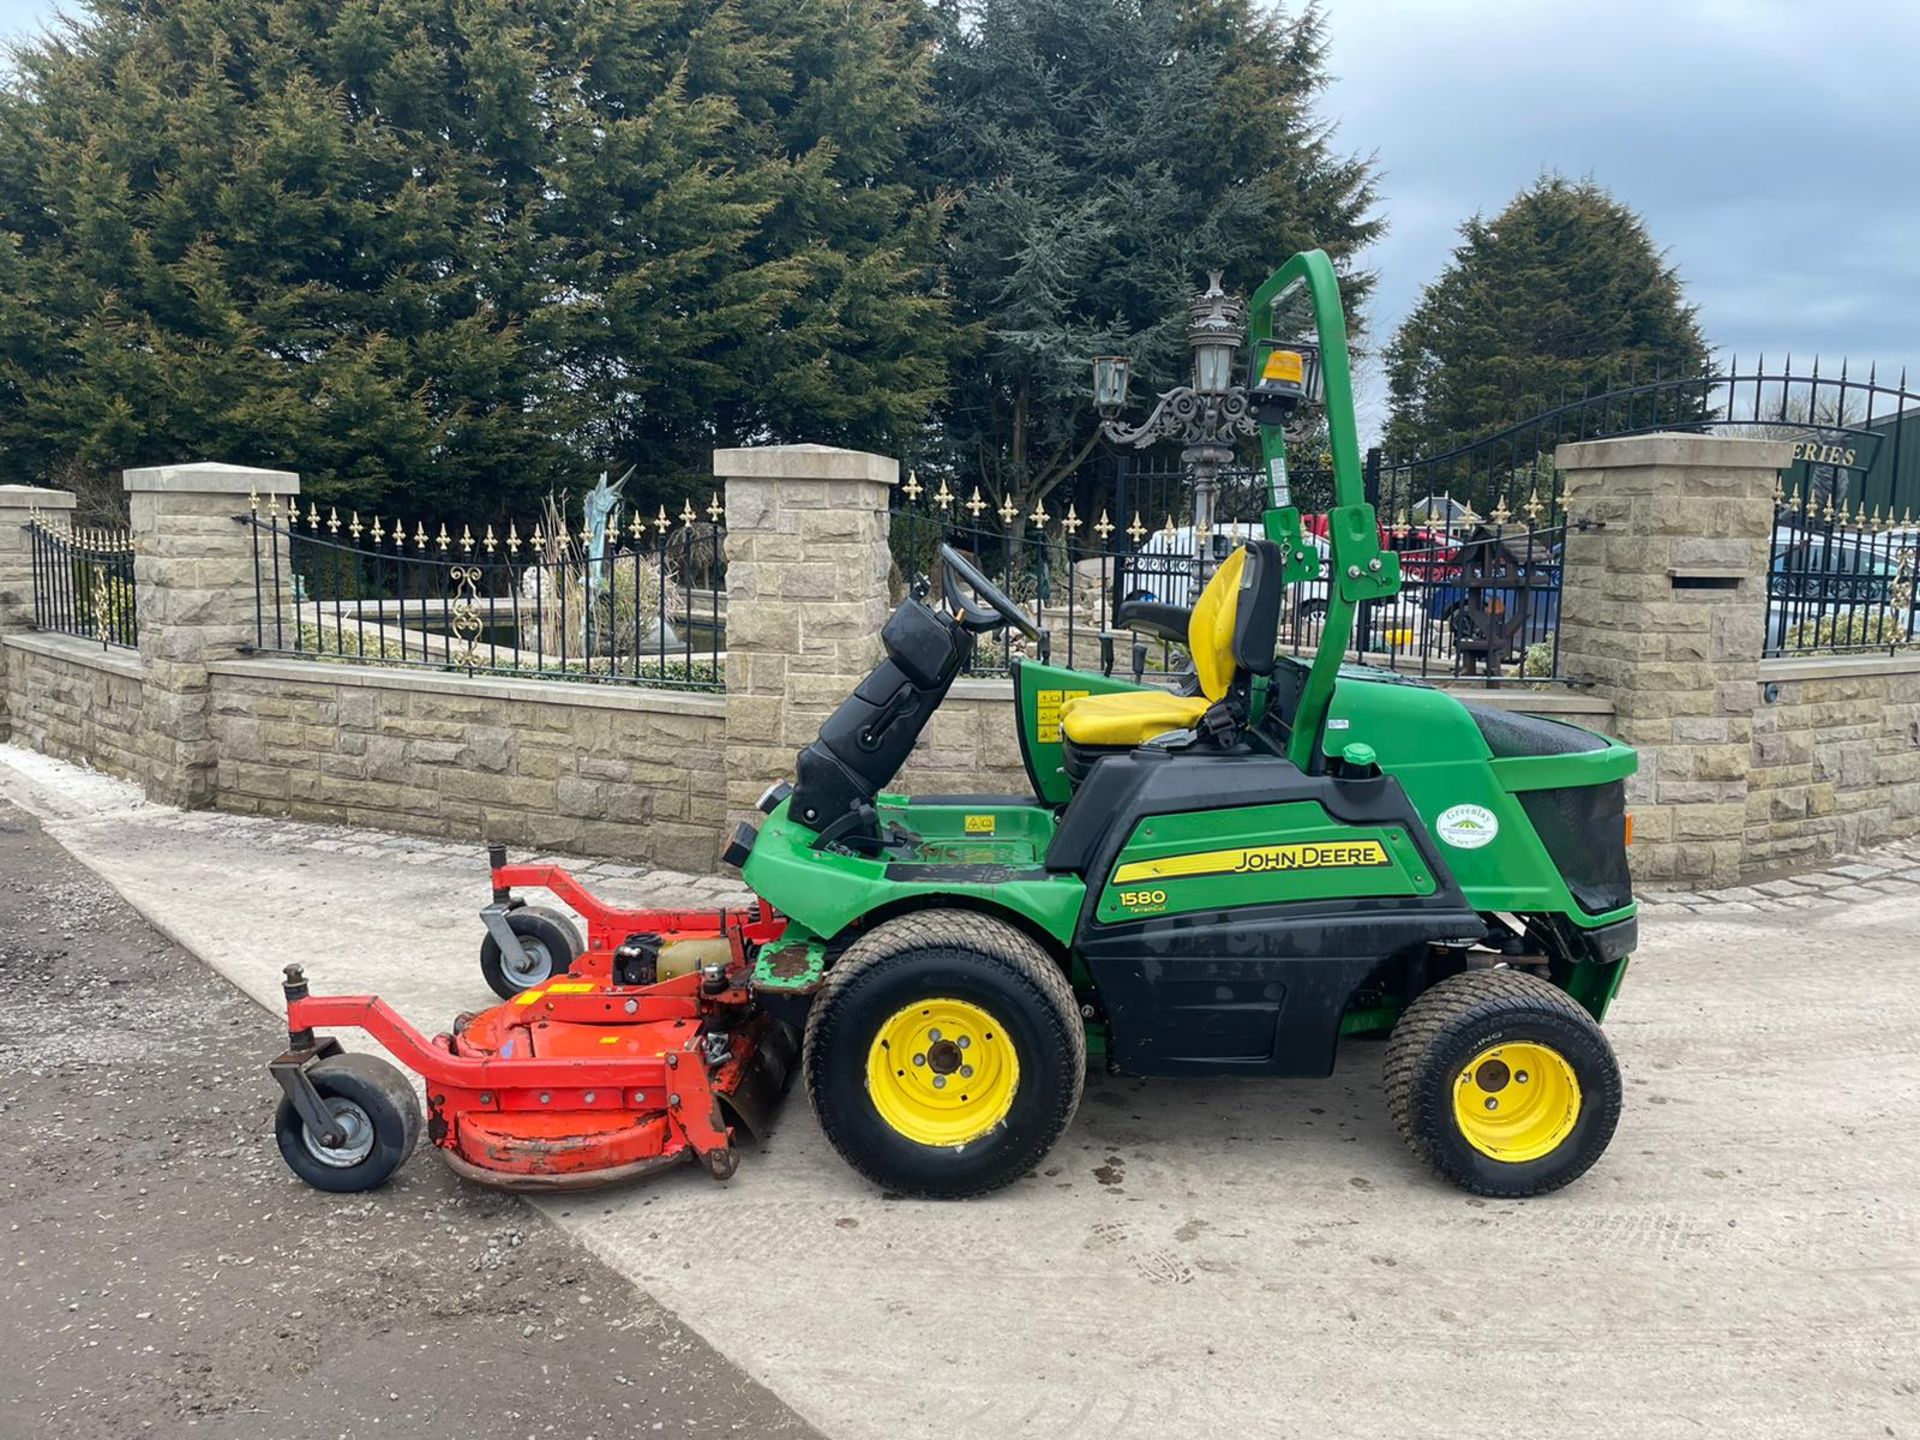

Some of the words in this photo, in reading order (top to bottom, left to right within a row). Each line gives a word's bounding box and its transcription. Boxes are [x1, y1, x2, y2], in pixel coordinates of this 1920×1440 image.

[1235, 850, 1296, 872] JOHN
[1302, 847, 1376, 866] DEERE
[1120, 890, 1166, 906] 1580
